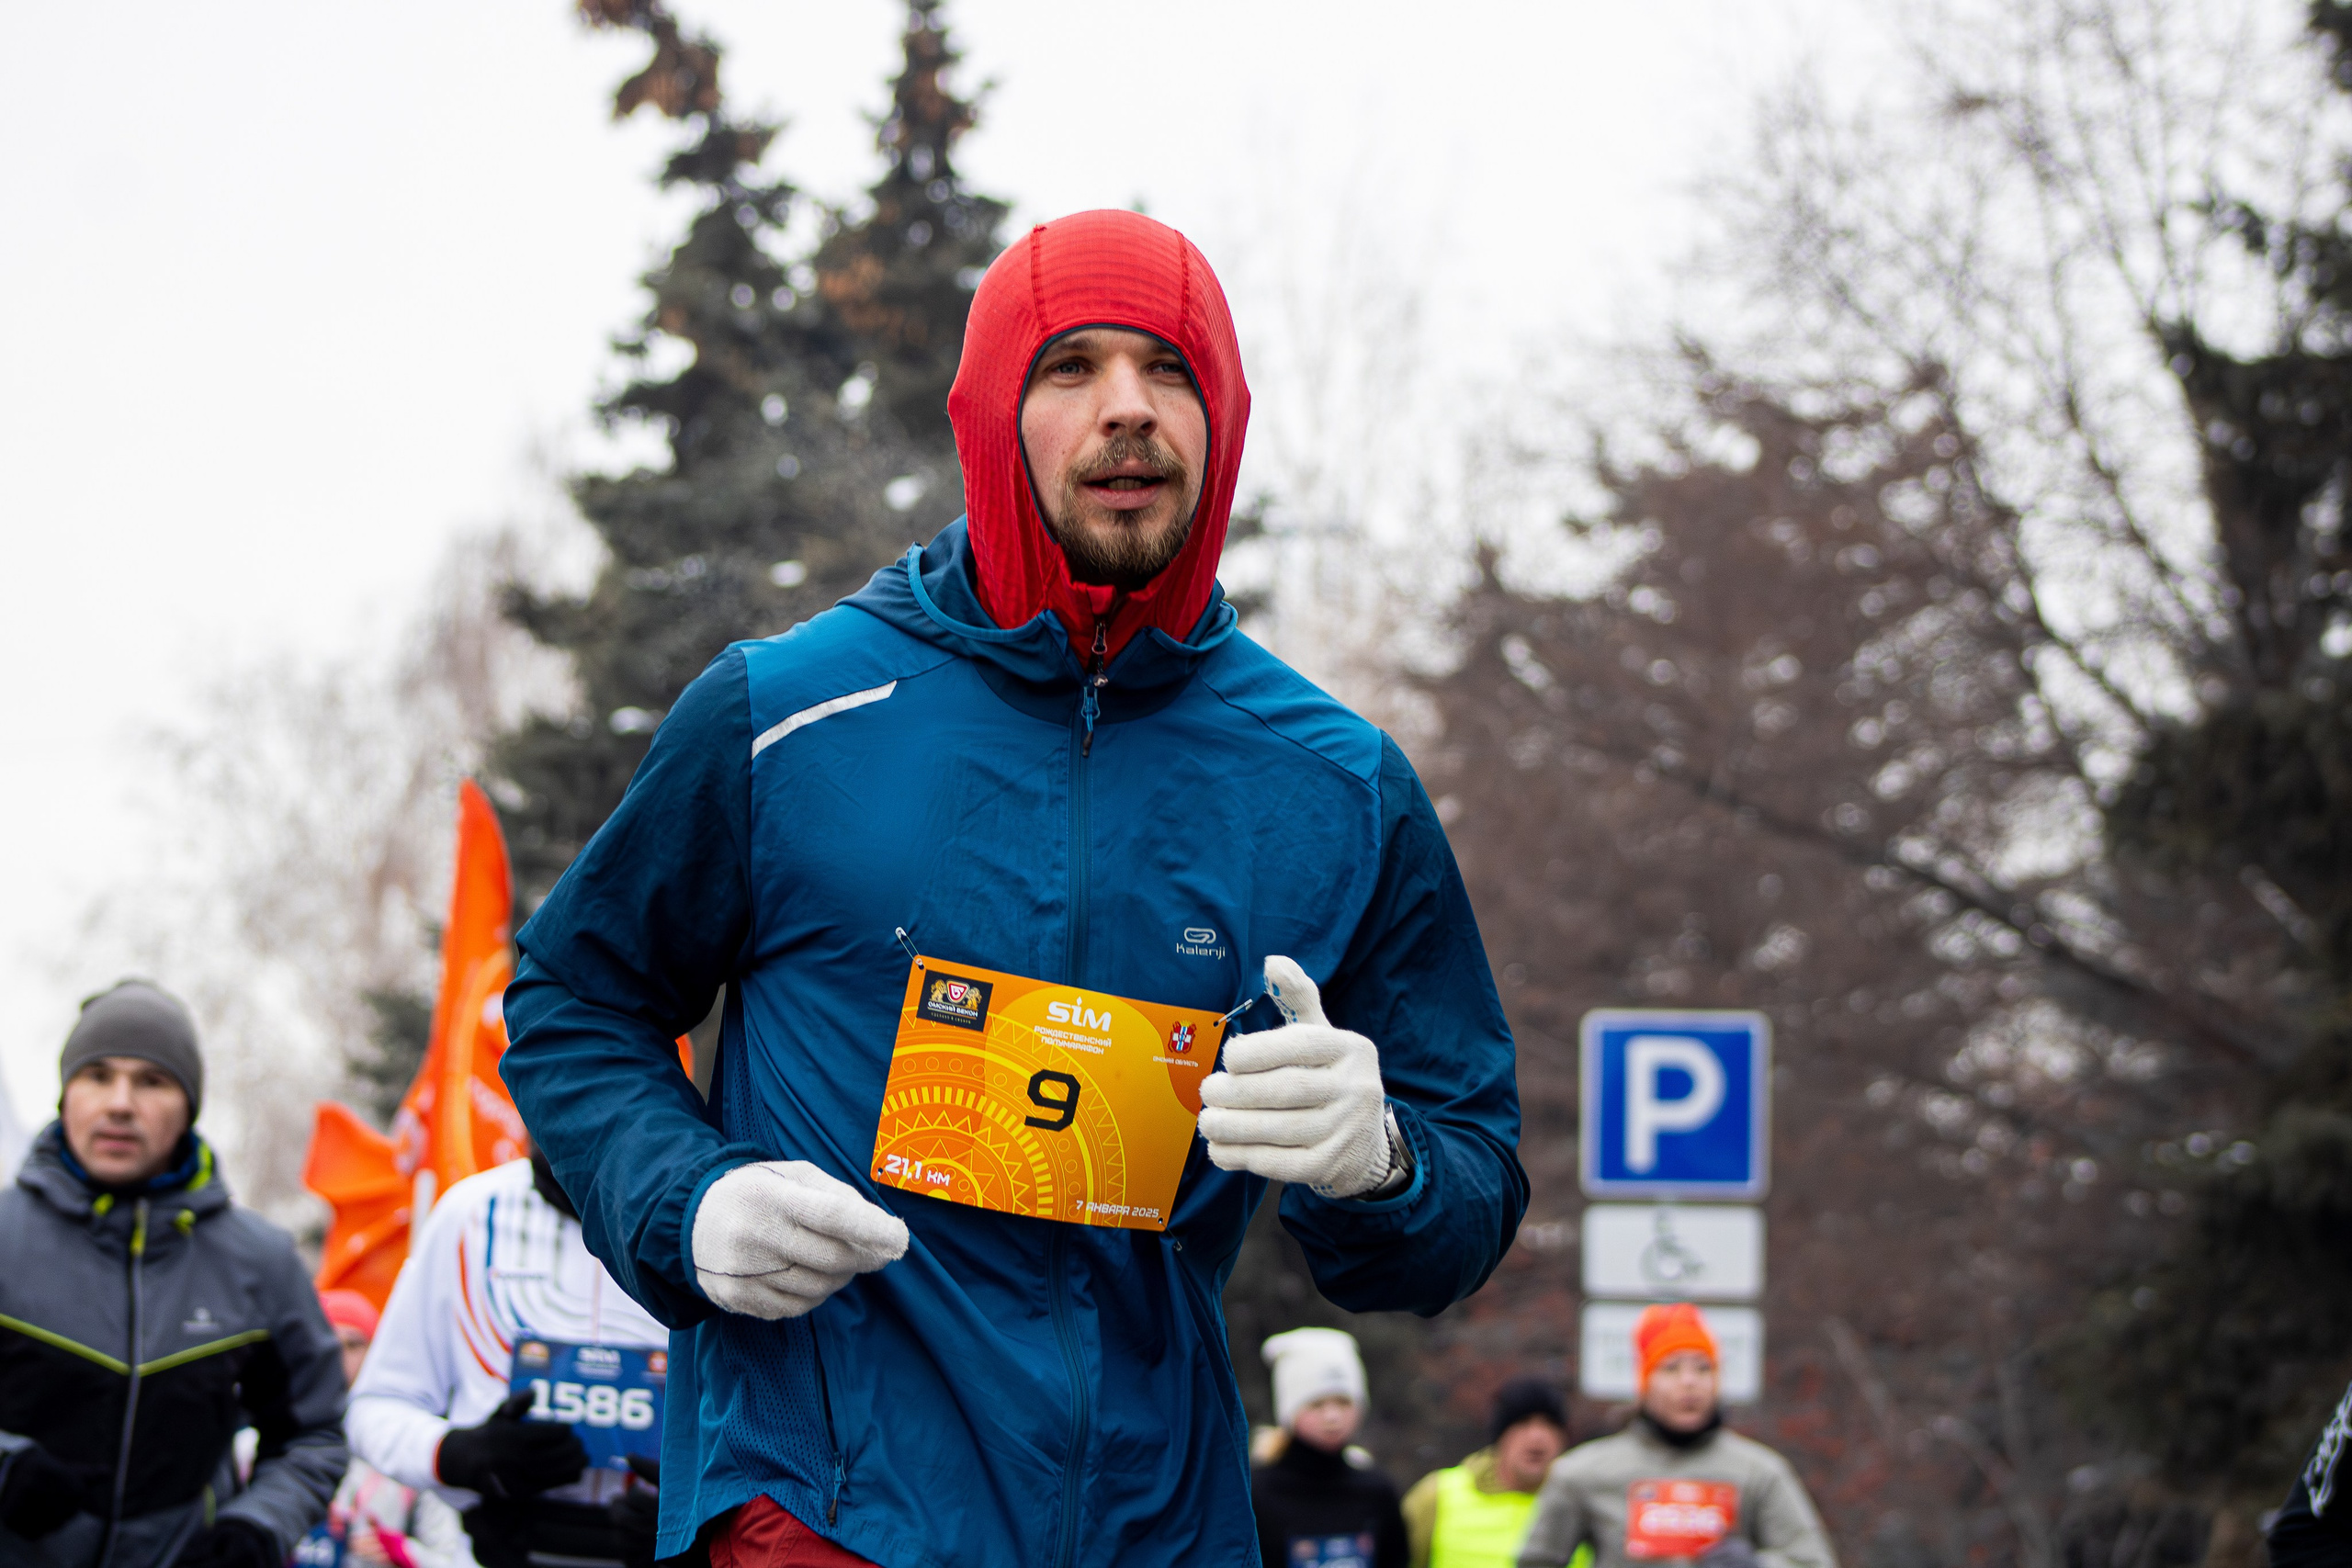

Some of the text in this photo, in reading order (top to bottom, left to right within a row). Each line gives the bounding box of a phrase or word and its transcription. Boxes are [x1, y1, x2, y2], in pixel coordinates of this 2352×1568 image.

[1176, 942, 1226, 960] Kalenji
[1034, 1025, 1113, 1048] РОЖДЕСТВЕНСКИЙ
[1041, 1035, 1104, 1055] ПОЛУМАРАФОН
[1024, 1068, 1081, 1133] 9
[1624, 1034, 1727, 1175] P
[885, 1154, 922, 1179] 21,1
[1076, 1200, 1159, 1218] 7 ЯНВАРЯ 2025
[528, 1378, 655, 1430] 1586
